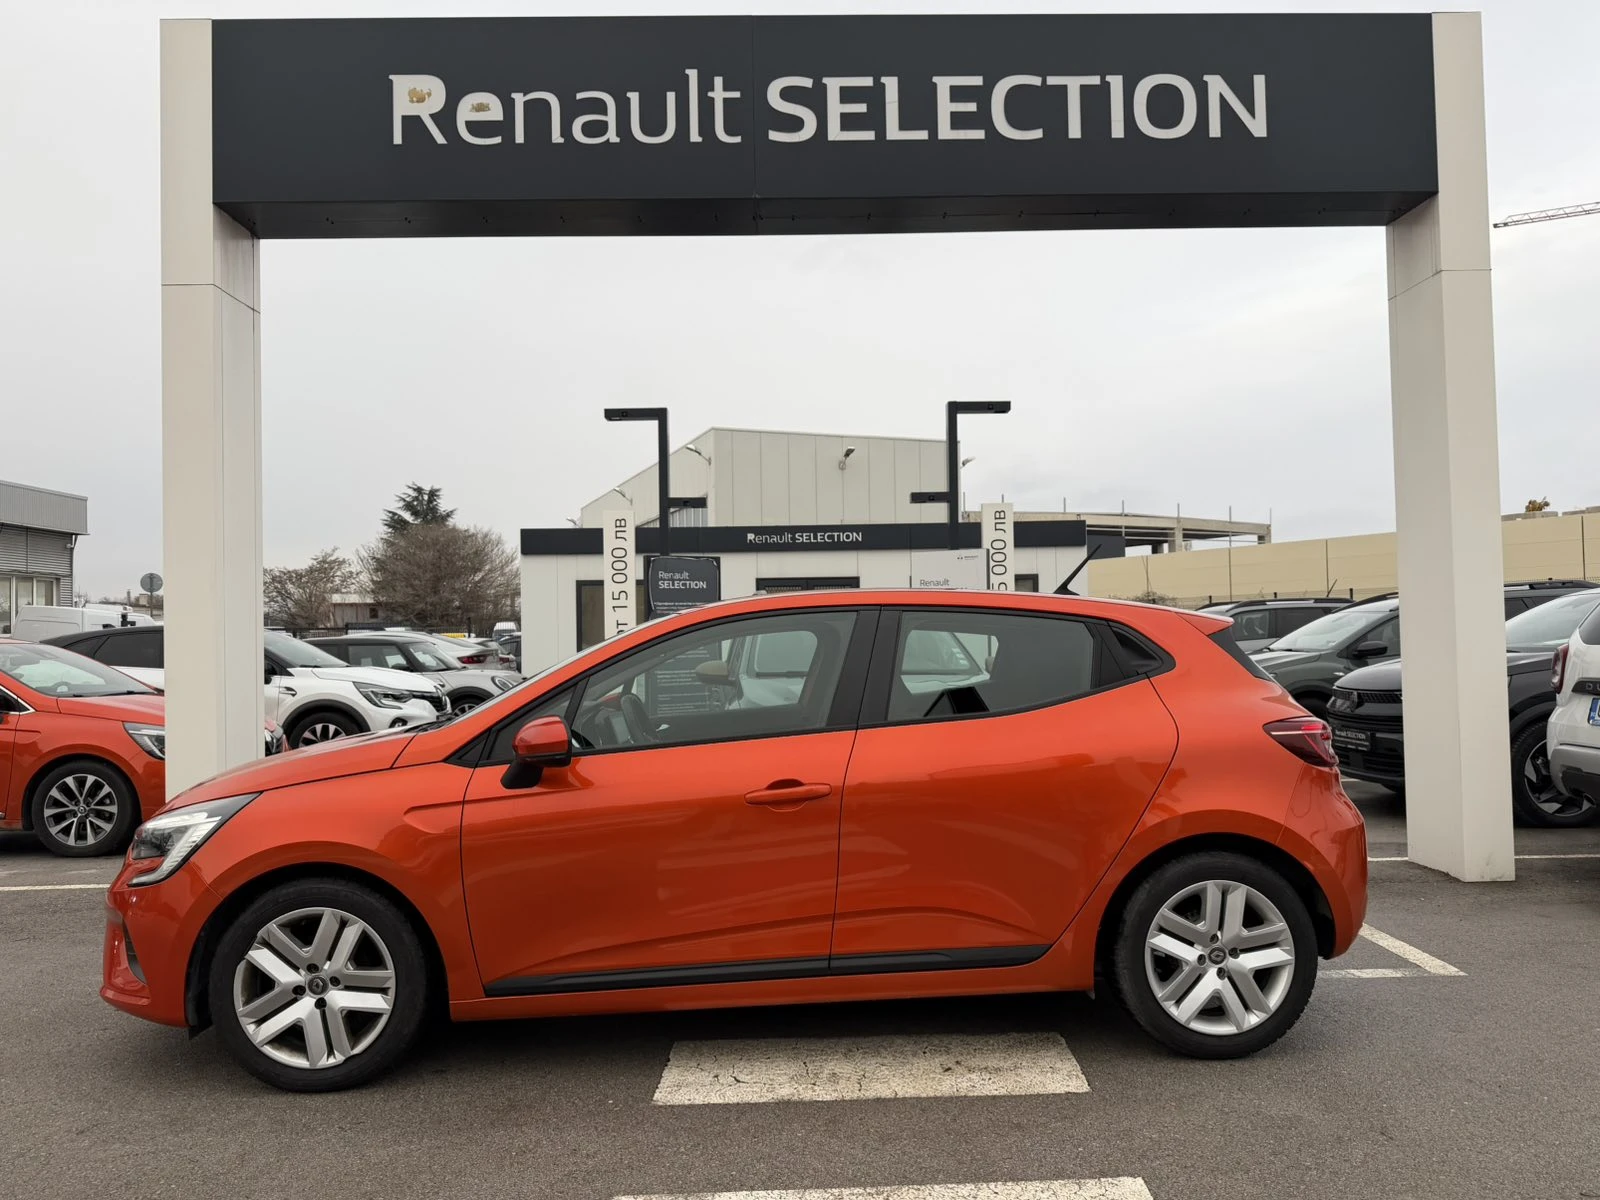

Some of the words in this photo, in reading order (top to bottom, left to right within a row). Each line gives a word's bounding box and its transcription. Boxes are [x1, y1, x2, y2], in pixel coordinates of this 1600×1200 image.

[388, 68, 742, 146] Renault
[766, 73, 1268, 143] SELECTION
[614, 518, 627, 542] лв
[994, 510, 1007, 533] лв
[747, 532, 793, 544] Renault
[795, 531, 863, 543] SELECTION
[610, 547, 628, 584] 000
[990, 539, 1007, 576] 000
[658, 570, 690, 580] Renault
[658, 580, 707, 589] SELECTION
[919, 578, 950, 587] Renault
[611, 590, 628, 613] 15
